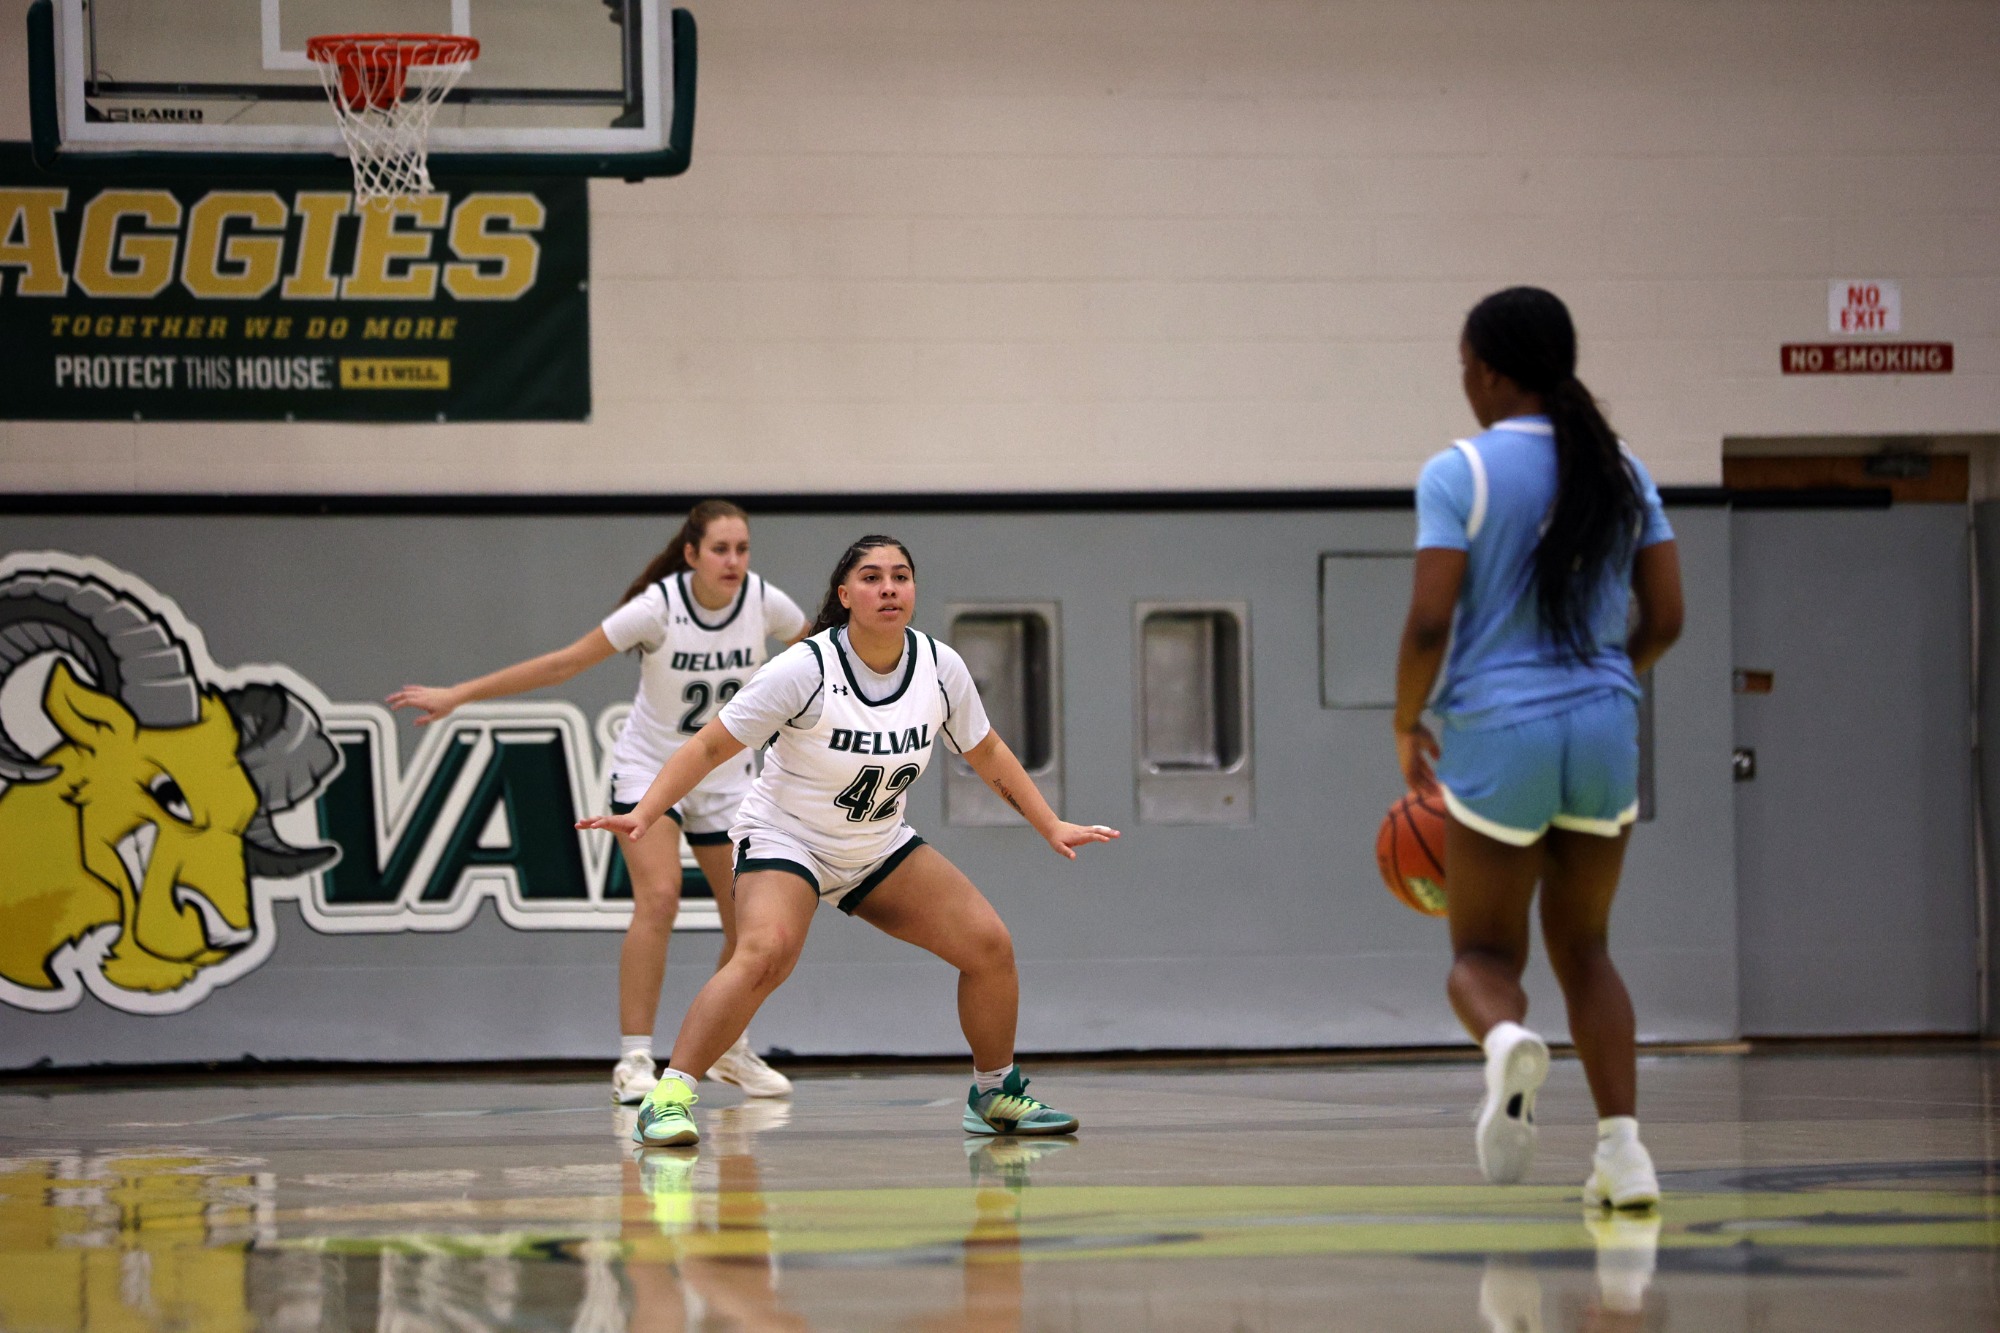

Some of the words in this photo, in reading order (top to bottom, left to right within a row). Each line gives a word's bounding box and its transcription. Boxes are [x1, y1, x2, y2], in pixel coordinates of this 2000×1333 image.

[131, 108, 203, 123] GARED
[0, 187, 547, 299] AGGIES
[1848, 284, 1880, 308] NO
[51, 315, 228, 338] TOGETHER
[245, 317, 292, 339] WE
[306, 317, 349, 339] DO
[362, 317, 457, 340] MORE
[1840, 309, 1888, 331] EXIT
[1790, 349, 1823, 369] NO
[1834, 347, 1943, 369] SMOKING
[55, 356, 175, 388] PROTECT
[184, 357, 231, 389] THIS
[670, 647, 755, 672] DELVAL
[828, 723, 932, 756] DELVAL
[833, 762, 920, 823] 42
